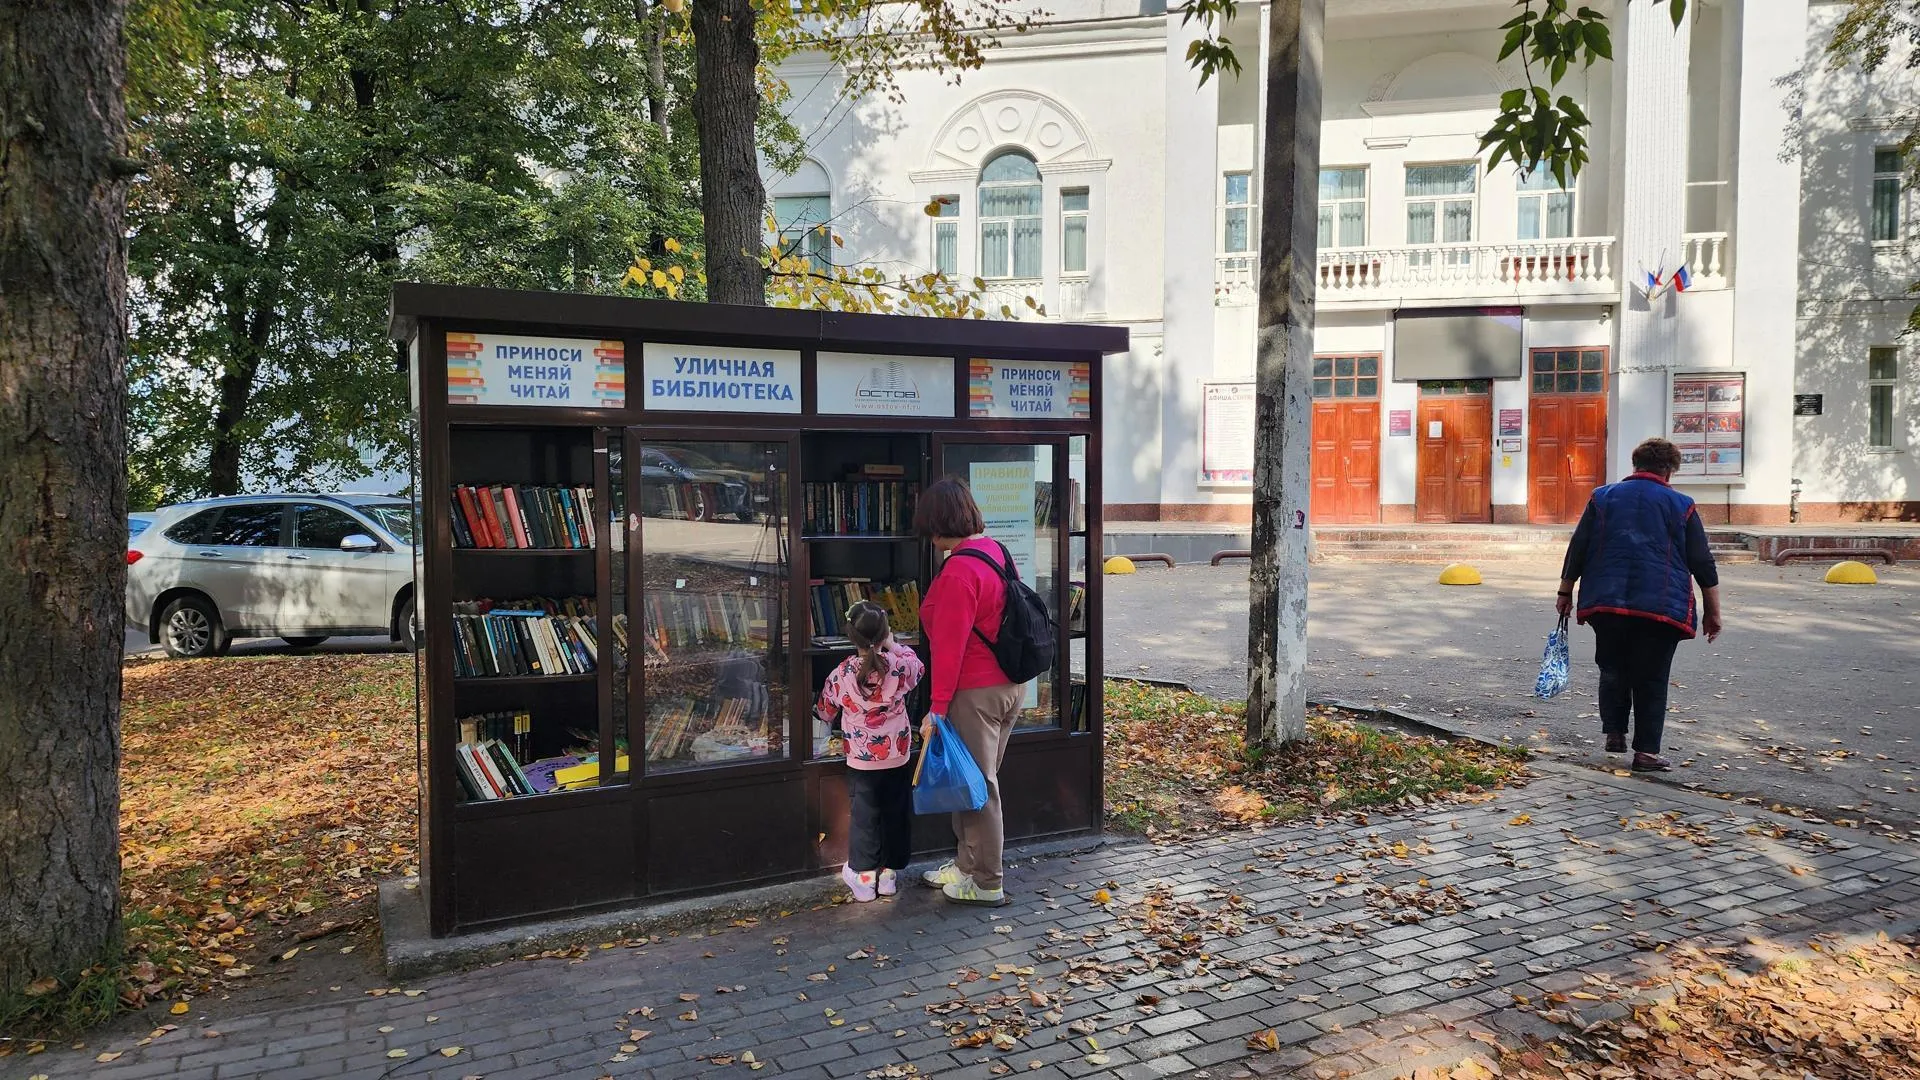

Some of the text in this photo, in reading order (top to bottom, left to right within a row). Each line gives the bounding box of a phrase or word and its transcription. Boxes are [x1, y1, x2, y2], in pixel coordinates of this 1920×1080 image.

[495, 345, 582, 363] ПРИНОСИ
[507, 363, 572, 381] МЕНЯЙ
[674, 357, 775, 378] УЛИЧНАЯ
[1001, 367, 1061, 382] ПРИНОСИ
[510, 382, 570, 400] ЧИТАЙ
[652, 379, 794, 401] БИБЛИОТЕКА
[859, 389, 916, 398] ОСТОВ
[1009, 382, 1054, 397] МЕНЯЙ
[1011, 398, 1052, 413] ЧИТАЙ
[976, 468, 1030, 479] ПРАВИЛА
